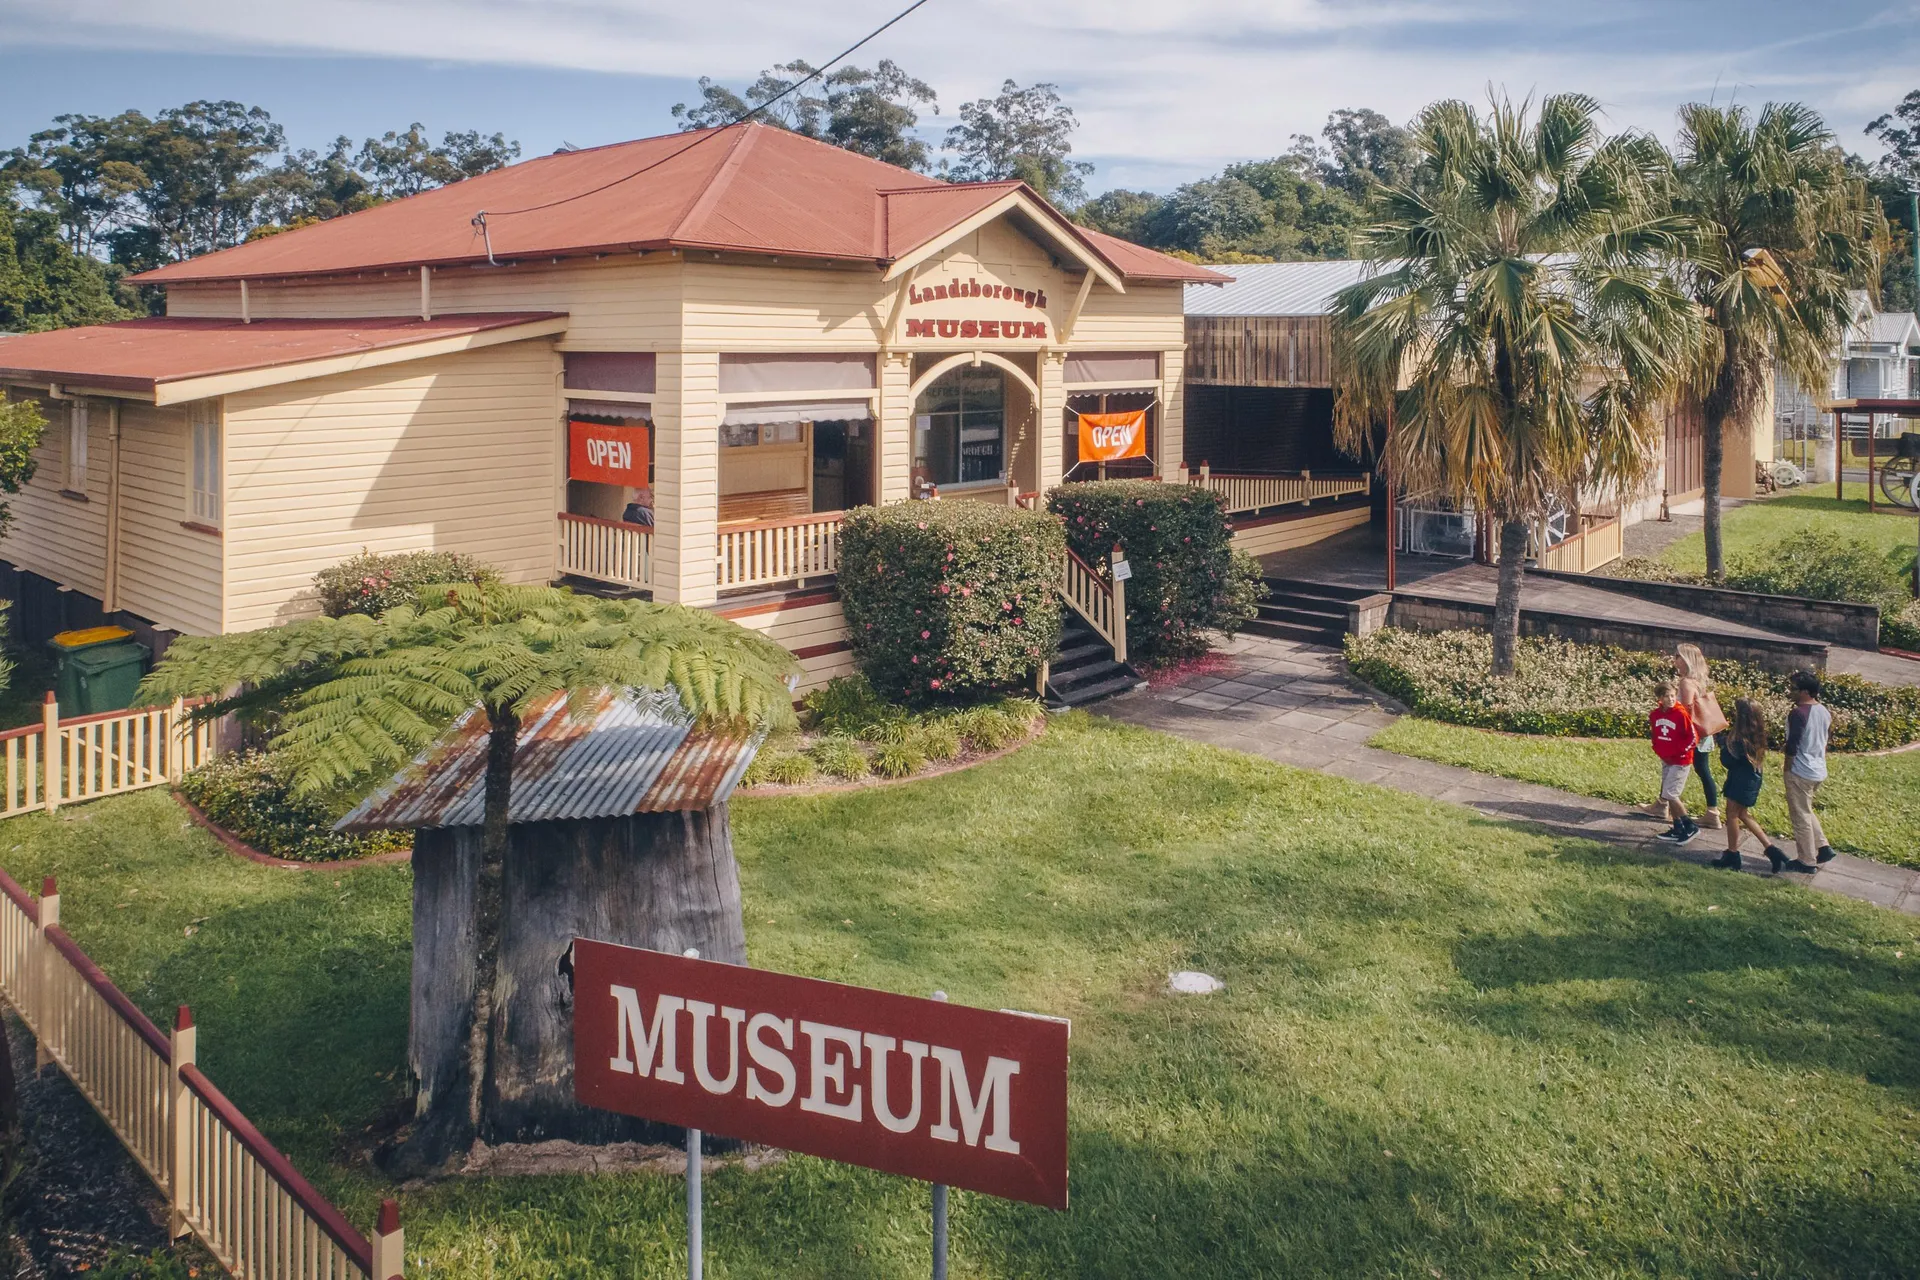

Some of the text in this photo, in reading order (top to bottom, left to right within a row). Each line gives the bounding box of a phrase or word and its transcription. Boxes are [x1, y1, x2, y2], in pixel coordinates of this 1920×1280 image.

[908, 278, 1047, 309] Landsborough
[906, 319, 1047, 338] MUSEUM
[1092, 424, 1133, 448] OPEN
[586, 438, 632, 470] OPEN
[610, 984, 1021, 1155] MUSEUM
